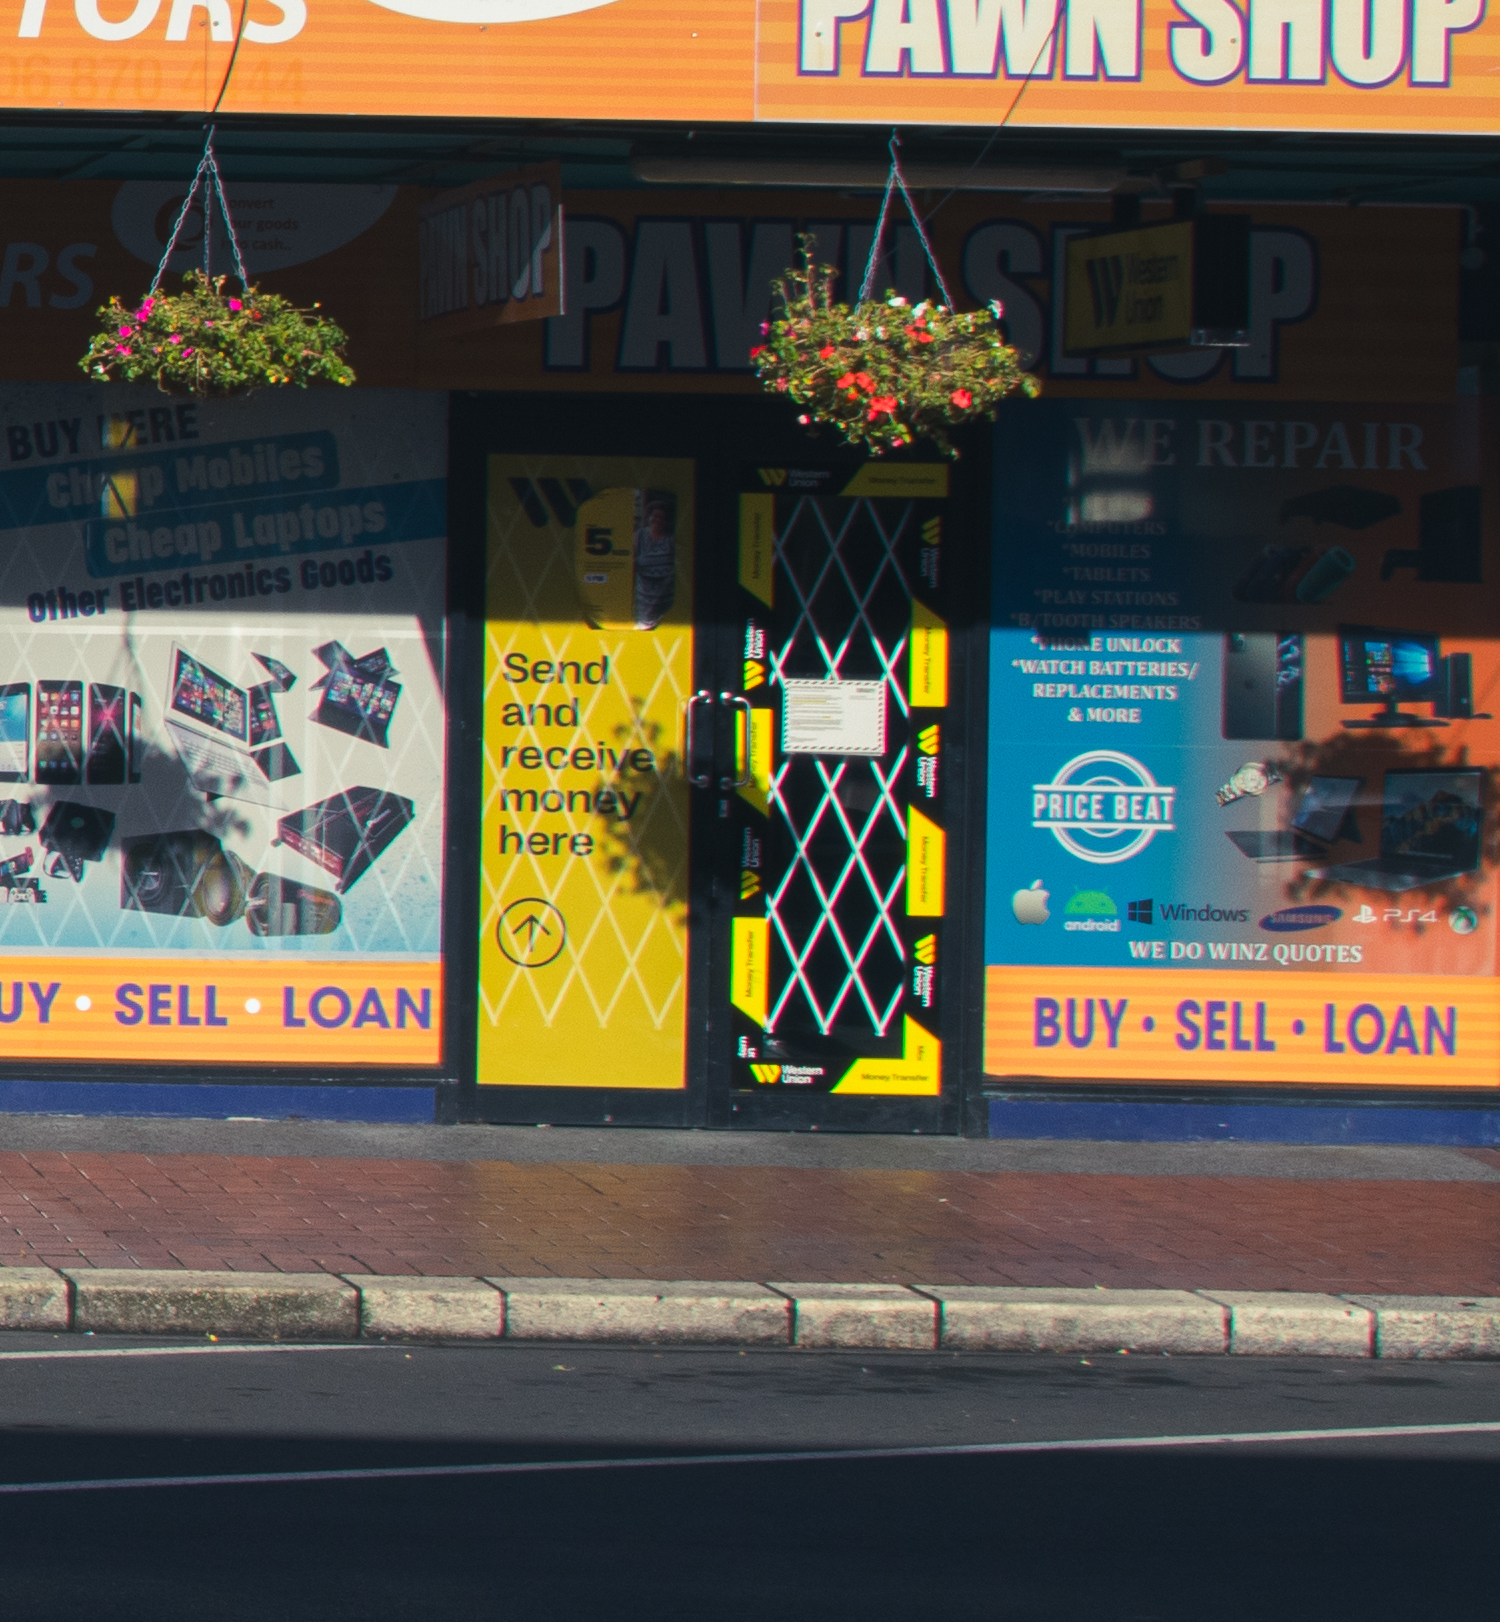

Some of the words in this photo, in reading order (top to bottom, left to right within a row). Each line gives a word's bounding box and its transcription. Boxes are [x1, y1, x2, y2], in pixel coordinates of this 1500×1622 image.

[472, 184, 551, 306] SHOP
[6, 415, 82, 462] BUY
[1196, 418, 1430, 471] REPAIR
[176, 444, 325, 494] Mobiles
[104, 519, 223, 565] Cheap
[233, 500, 388, 551] Laptops
[27, 586, 110, 624] Other
[119, 563, 293, 613] Electronics
[300, 549, 394, 590] Goods
[1106, 637, 1182, 654] UNLOCK
[502, 653, 609, 685] Send
[1032, 682, 1179, 701] REPLACEMENTS
[501, 697, 579, 727] and
[1067, 706, 1084, 723] &
[1086, 707, 1142, 724] MORE
[501, 741, 655, 773] receive
[500, 787, 642, 822] money
[1032, 793, 1105, 821] PRICE
[1113, 794, 1175, 821] BEAT
[498, 824, 594, 856] here
[1064, 918, 1122, 932] android
[1160, 902, 1249, 923] Windows
[1383, 908, 1439, 923] PS4
[1128, 940, 1165, 959] WE
[1170, 941, 1203, 960] DO
[1208, 942, 1269, 962] WINZ
[1272, 943, 1364, 964] QUOTES
[114, 982, 228, 1029] SELL
[280, 985, 432, 1032] LOAN
[1032, 996, 1129, 1049] BUY
[1174, 998, 1277, 1052] SELL
[1323, 1002, 1456, 1056] LOAN
